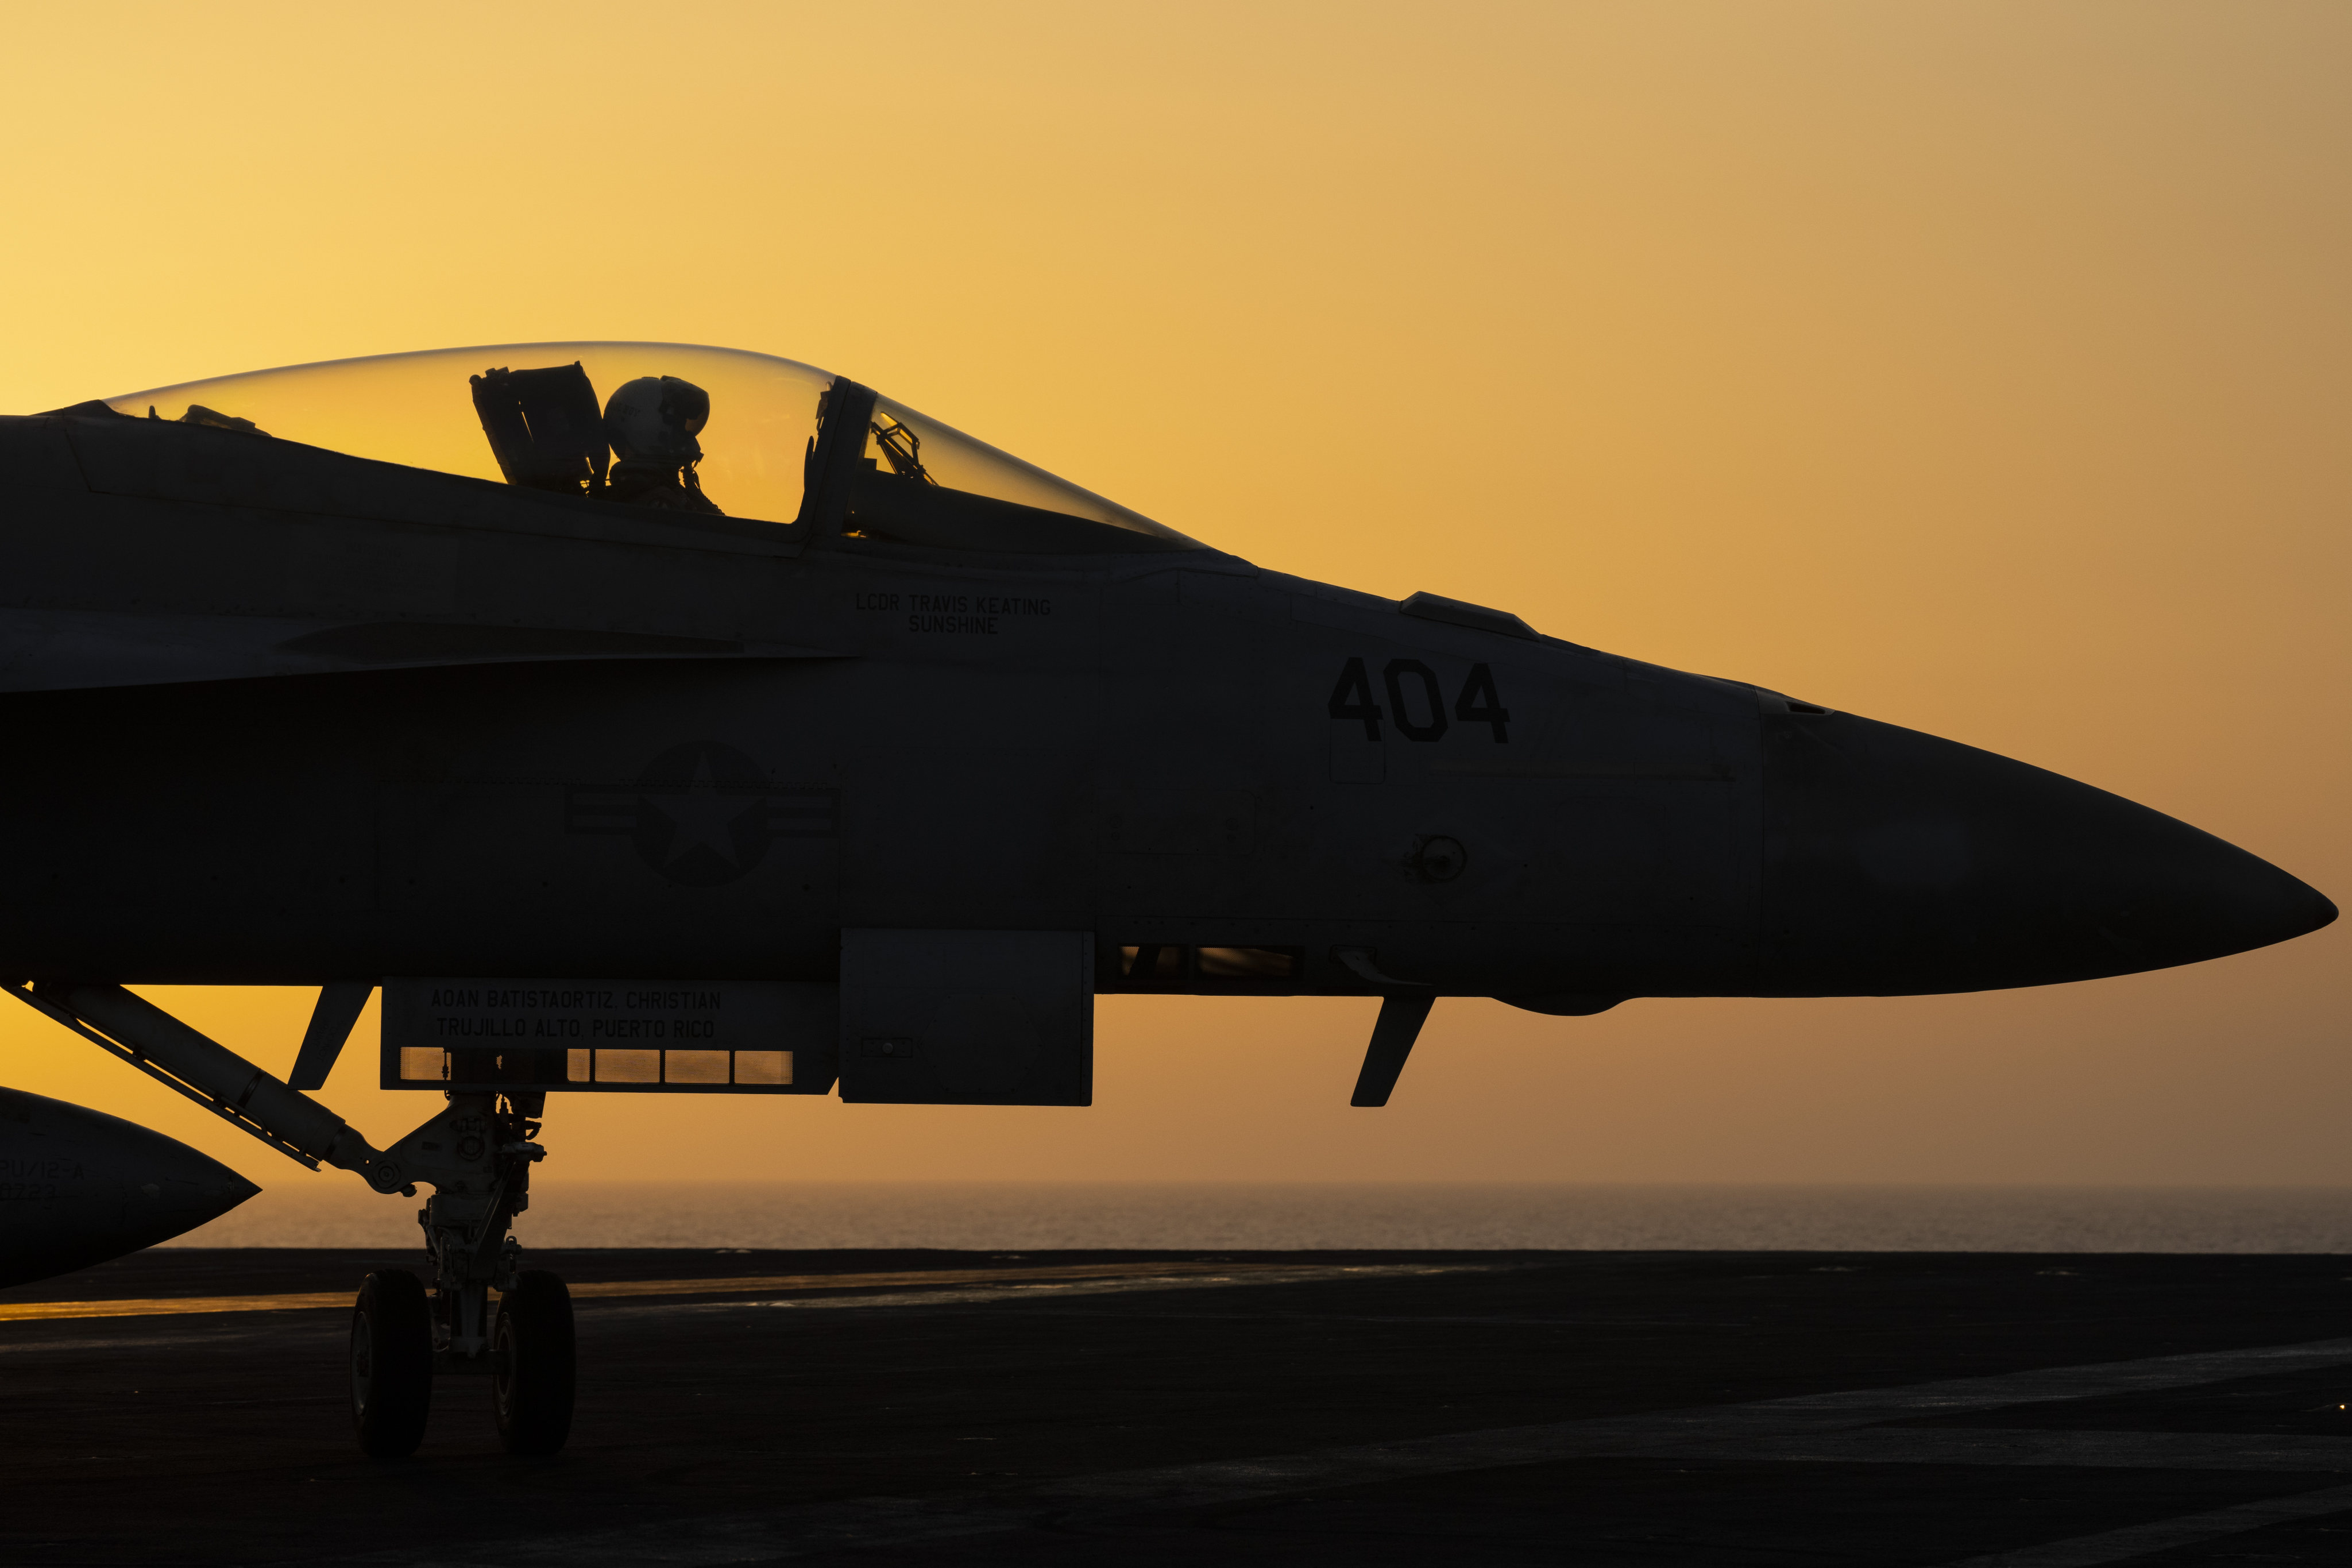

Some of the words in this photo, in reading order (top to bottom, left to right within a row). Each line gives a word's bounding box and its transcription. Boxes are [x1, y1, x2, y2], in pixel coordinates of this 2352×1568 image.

[856, 593, 899, 611] LCDR
[909, 594, 968, 612] TRAVIS
[976, 597, 1051, 615] KEATING
[909, 615, 998, 634] SUNSHINE
[1328, 657, 1510, 743] 404
[487, 990, 617, 1010] BATISTAORTIZ,
[627, 991, 720, 1009] CHRISTIAN
[437, 1017, 526, 1036] TRUJILLO
[534, 1018, 584, 1040] ALTO,
[593, 1019, 665, 1038] PUERTO
[673, 1020, 714, 1038] RICO
